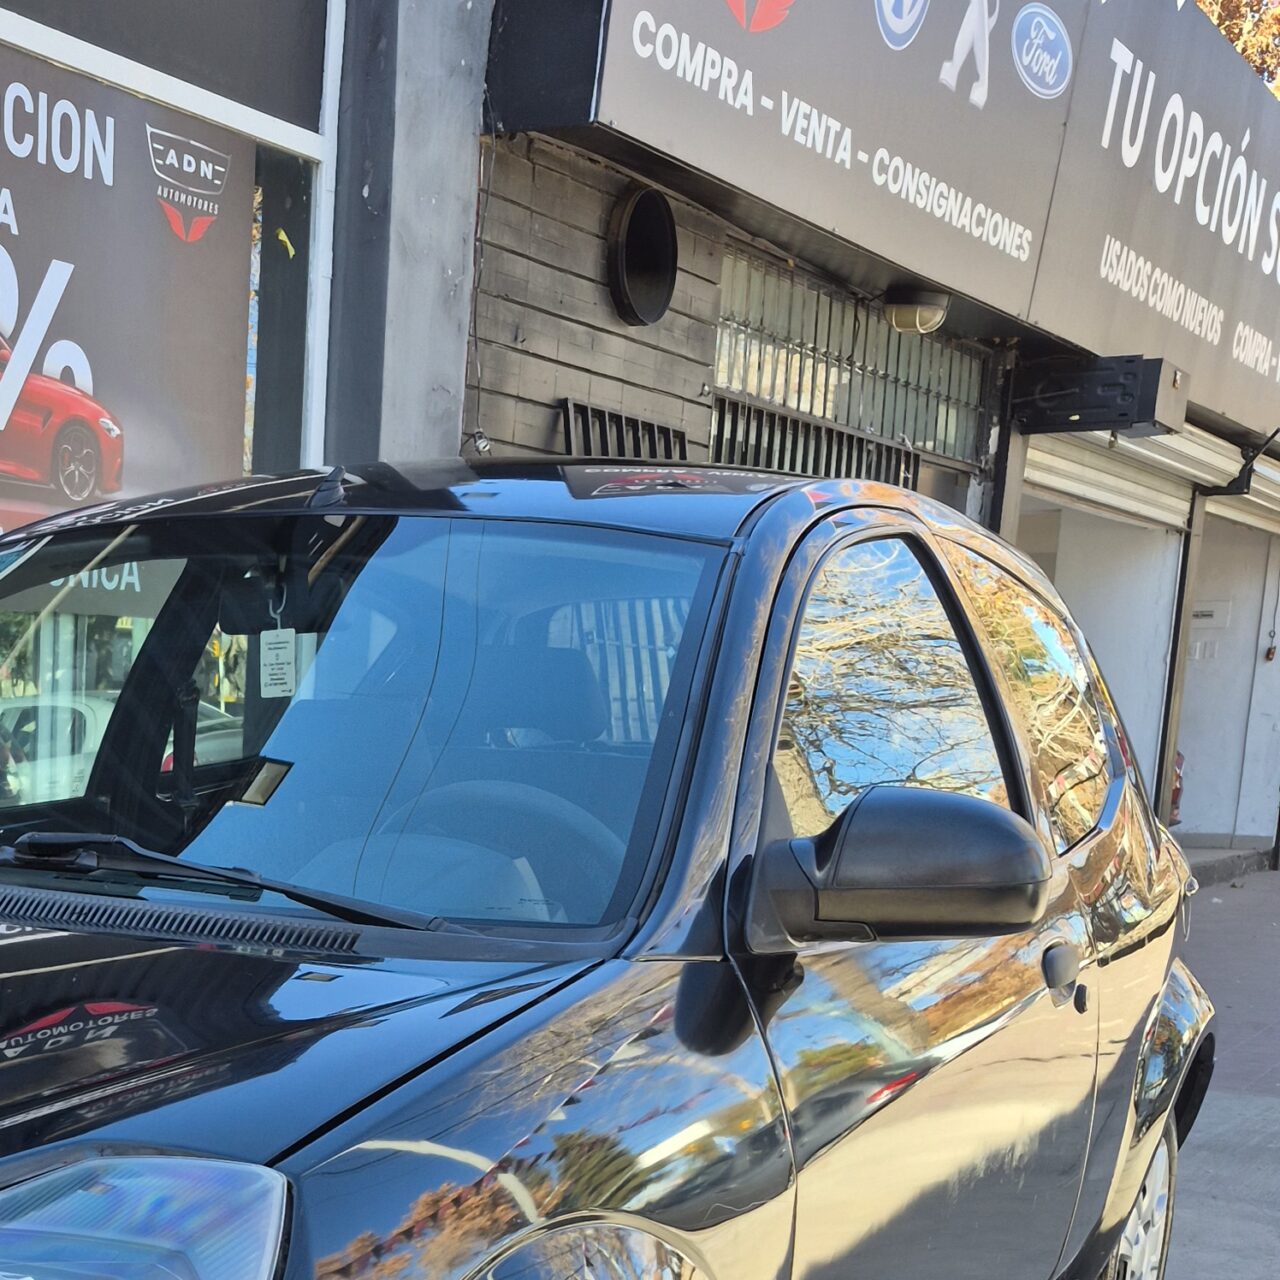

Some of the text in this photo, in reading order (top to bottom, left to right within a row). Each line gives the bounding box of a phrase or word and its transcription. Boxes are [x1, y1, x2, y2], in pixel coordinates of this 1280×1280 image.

[1021, 16, 1062, 86] Ford
[165, 148, 213, 180] ADN
[632, 11, 754, 117] COMPRA
[781, 90, 852, 169] VENTA
[872, 147, 1032, 263] CONSIGNACIONES
[1101, 37, 1156, 168] TU
[1154, 93, 1268, 261] OPCIÓN
[157, 185, 219, 215] AUTOMOTORES
[1100, 233, 1225, 346] USADOS COMO NUEVOS
[1232, 320, 1273, 377] COMPRA
